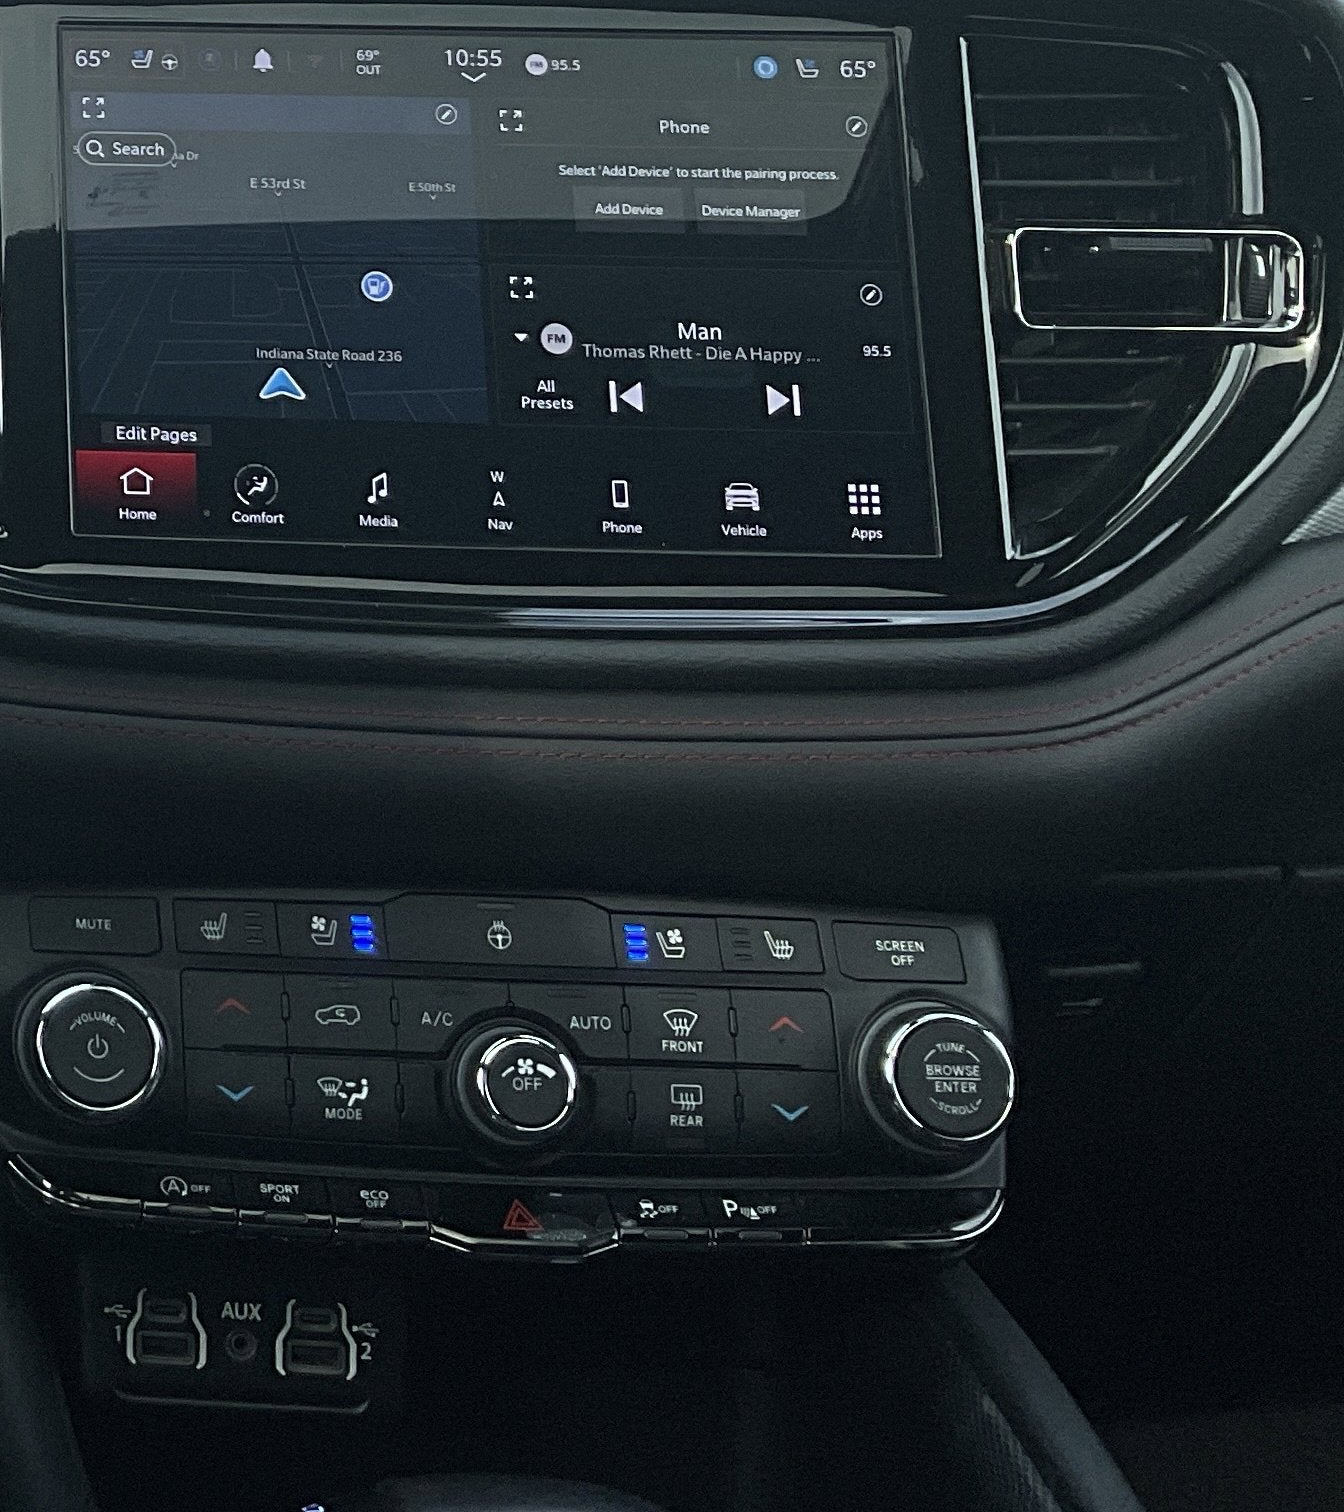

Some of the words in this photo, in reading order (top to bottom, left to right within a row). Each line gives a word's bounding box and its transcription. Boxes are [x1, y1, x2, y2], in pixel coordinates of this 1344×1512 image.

[74, 49, 111, 68] 65°
[356, 49, 380, 62] 69°
[444, 49, 503, 68] 10:55
[356, 64, 381, 75] OUT
[550, 59, 581, 71] 95.5
[839, 59, 877, 78] 65°
[659, 119, 710, 135] Phone
[112, 141, 165, 156] Search
[559, 164, 596, 177] Select
[598, 165, 627, 177] 'Add
[628, 165, 672, 178] Device'
[676, 167, 689, 178] to
[691, 167, 719, 179] start
[722, 167, 742, 179] the
[744, 168, 787, 182] pairing
[789, 170, 840, 183] process.
[250, 178, 258, 188] E
[260, 178, 290, 189] 53rd
[292, 179, 306, 190] St
[408, 182, 416, 192] E
[444, 183, 456, 193] St
[595, 203, 620, 215] Add
[622, 203, 664, 216] Device
[701, 204, 743, 217] Device
[745, 205, 801, 220] Manager
[546, 333, 566, 345] FM
[677, 322, 722, 341] Man
[255, 347, 304, 361] Indiana
[306, 349, 339, 361] State
[342, 349, 375, 362] Road
[377, 350, 403, 363] 236
[582, 344, 646, 360] Thomas
[649, 345, 692, 361] Rhett
[706, 346, 734, 361] Die
[735, 347, 748, 361] A
[750, 347, 803, 365] Happy
[862, 344, 892, 358] 95.5
[536, 380, 555, 394] All
[521, 396, 574, 410] Presets
[116, 425, 147, 441] Edit
[150, 426, 198, 444] Pages
[490, 470, 505, 483] W
[118, 508, 157, 521] Home
[231, 511, 284, 525] Comfort
[358, 514, 399, 528] Media
[487, 519, 513, 531] Nav
[602, 520, 643, 534] Phone
[720, 523, 767, 538] Vehicle
[850, 526, 883, 541] Apps
[75, 917, 112, 932] MUTE
[875, 939, 925, 954] SCREEN
[891, 953, 915, 967] OFF
[74, 1010, 118, 1028] VOLUME
[421, 1010, 454, 1028] A/C
[569, 1014, 612, 1031] AUTO
[661, 1039, 704, 1054] FRONT
[935, 1042, 966, 1055] TUNE
[925, 1063, 981, 1078] BROWSE
[512, 1076, 543, 1092] OFF
[934, 1079, 978, 1095] ENTER
[324, 1106, 363, 1121] MODE
[935, 1099, 979, 1116] SCROLL
[669, 1113, 704, 1128] REAR
[190, 1183, 212, 1194] OFF
[259, 1182, 300, 1196] SPORT
[360, 1189, 389, 1202] eco
[273, 1193, 291, 1204] ON
[365, 1199, 386, 1210] OFF
[658, 1203, 679, 1214] OFF
[722, 1199, 738, 1218] P
[757, 1204, 778, 1215] OFF
[220, 1301, 262, 1322] AUX
[114, 1325, 122, 1342] 1
[360, 1342, 373, 1361] 2
